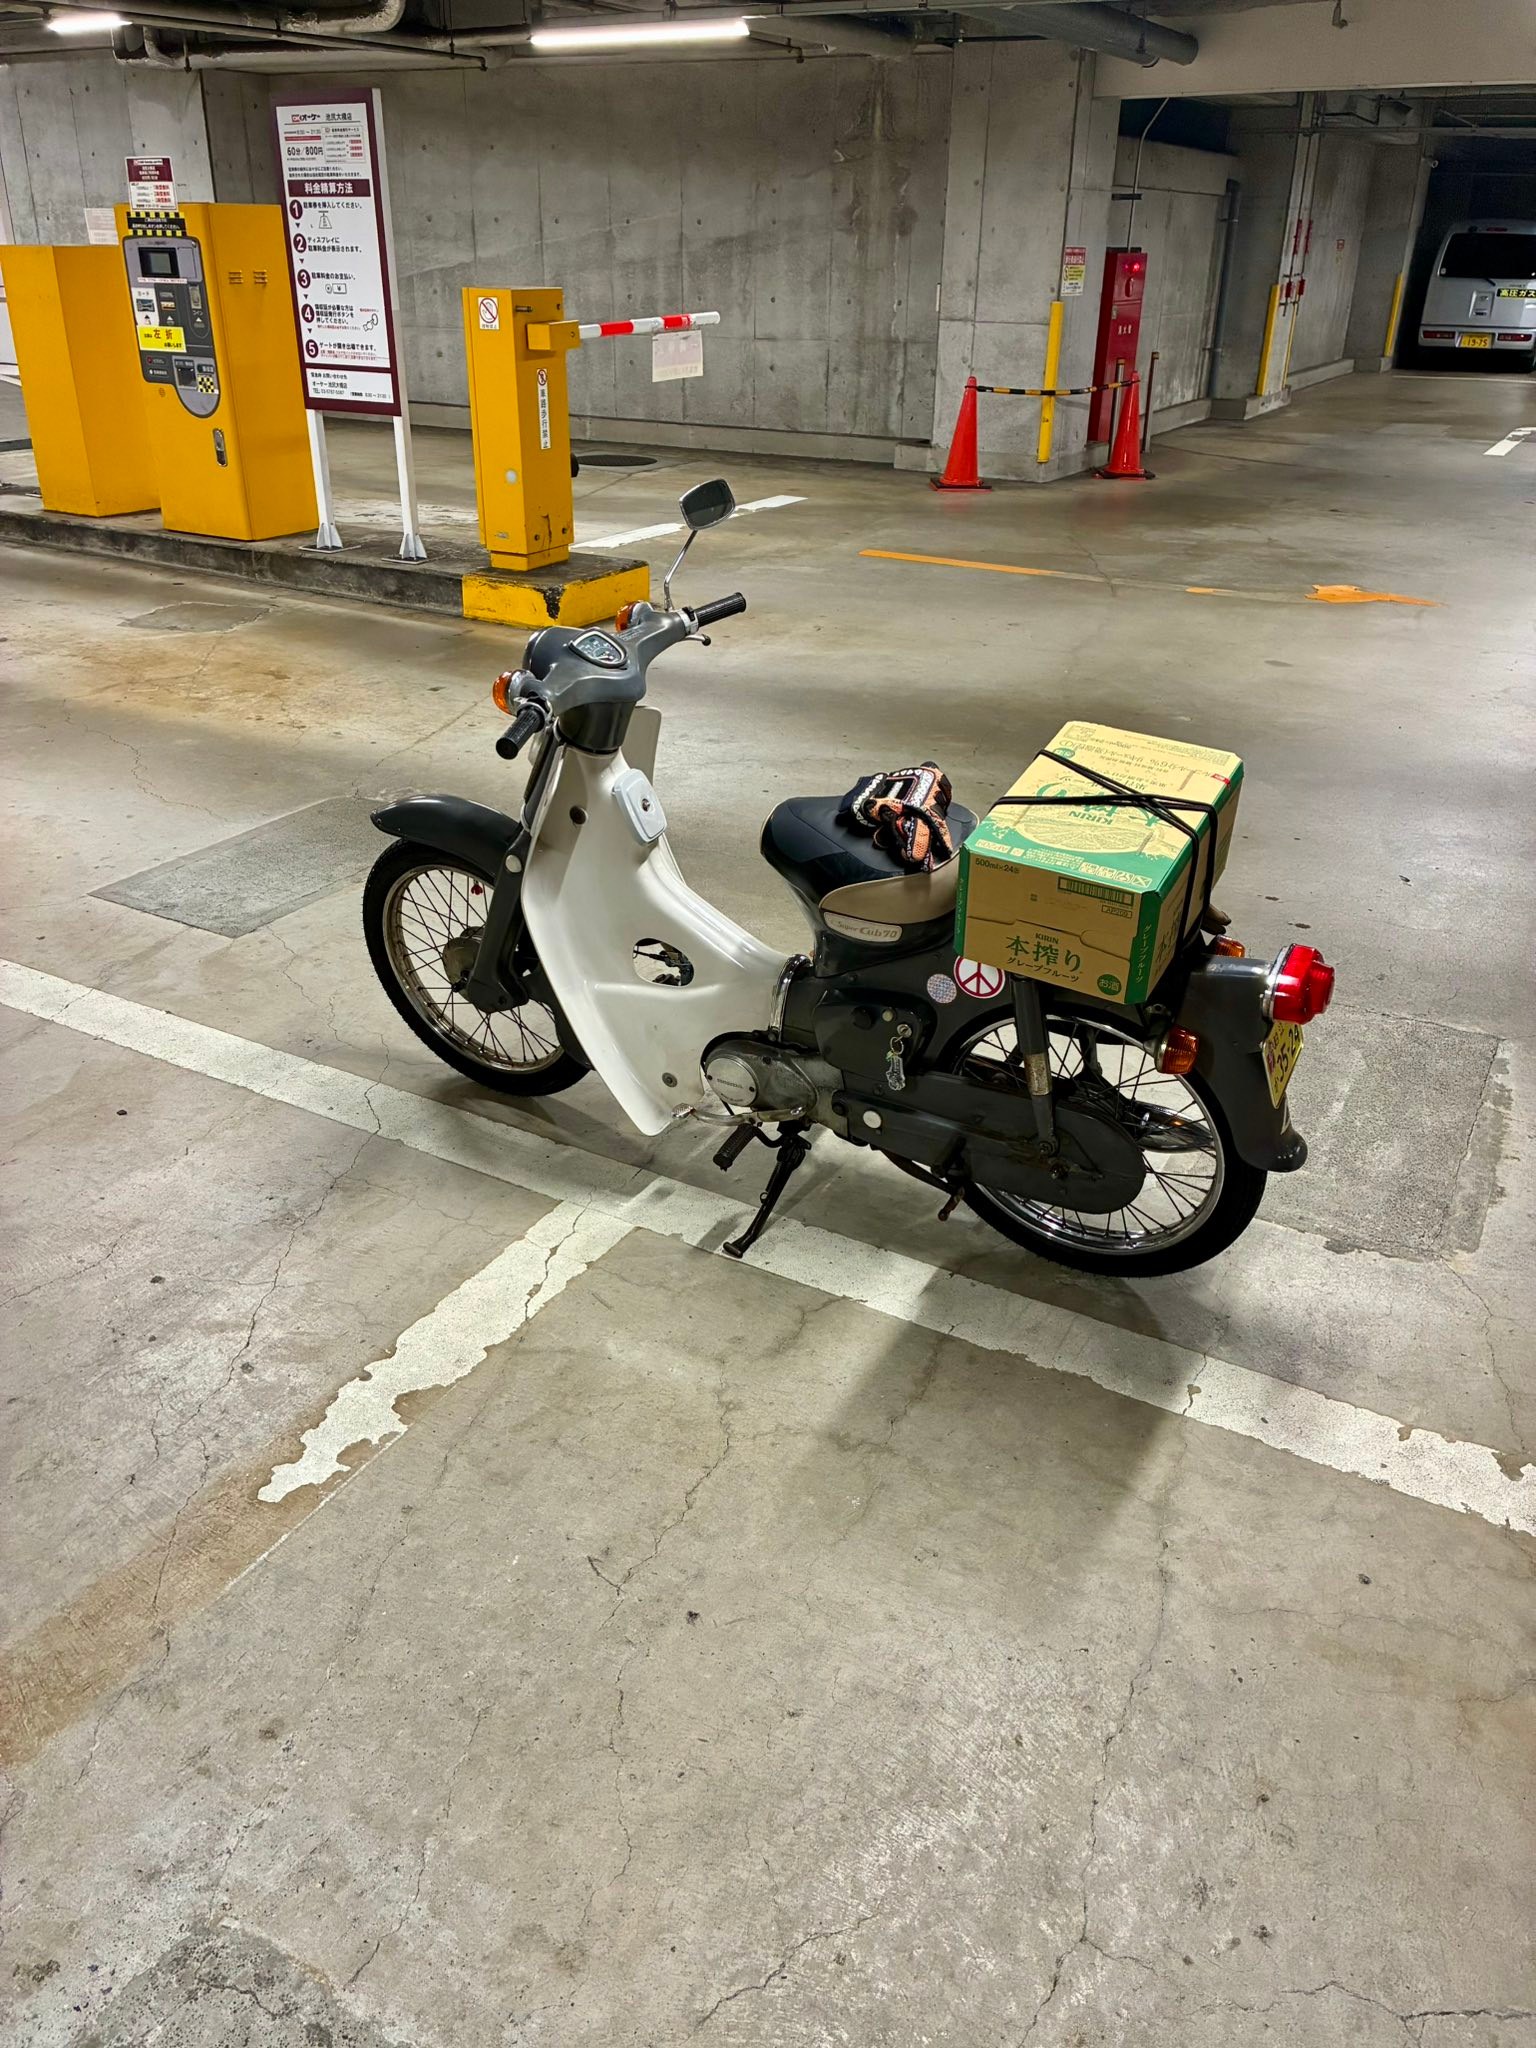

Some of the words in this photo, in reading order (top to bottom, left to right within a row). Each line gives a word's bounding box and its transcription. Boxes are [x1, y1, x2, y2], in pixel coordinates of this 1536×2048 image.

[304, 182, 353, 194] 料金精算方法
[1500, 289, 1536, 297] 高圧ガス
[1068, 810, 1114, 825] KIRIN
[1035, 932, 1059, 944] KIRIN
[1006, 936, 1080, 972] 本搾り
[1007, 956, 1080, 982] グレープフルーツ
[1099, 978, 1120, 991] お酒
